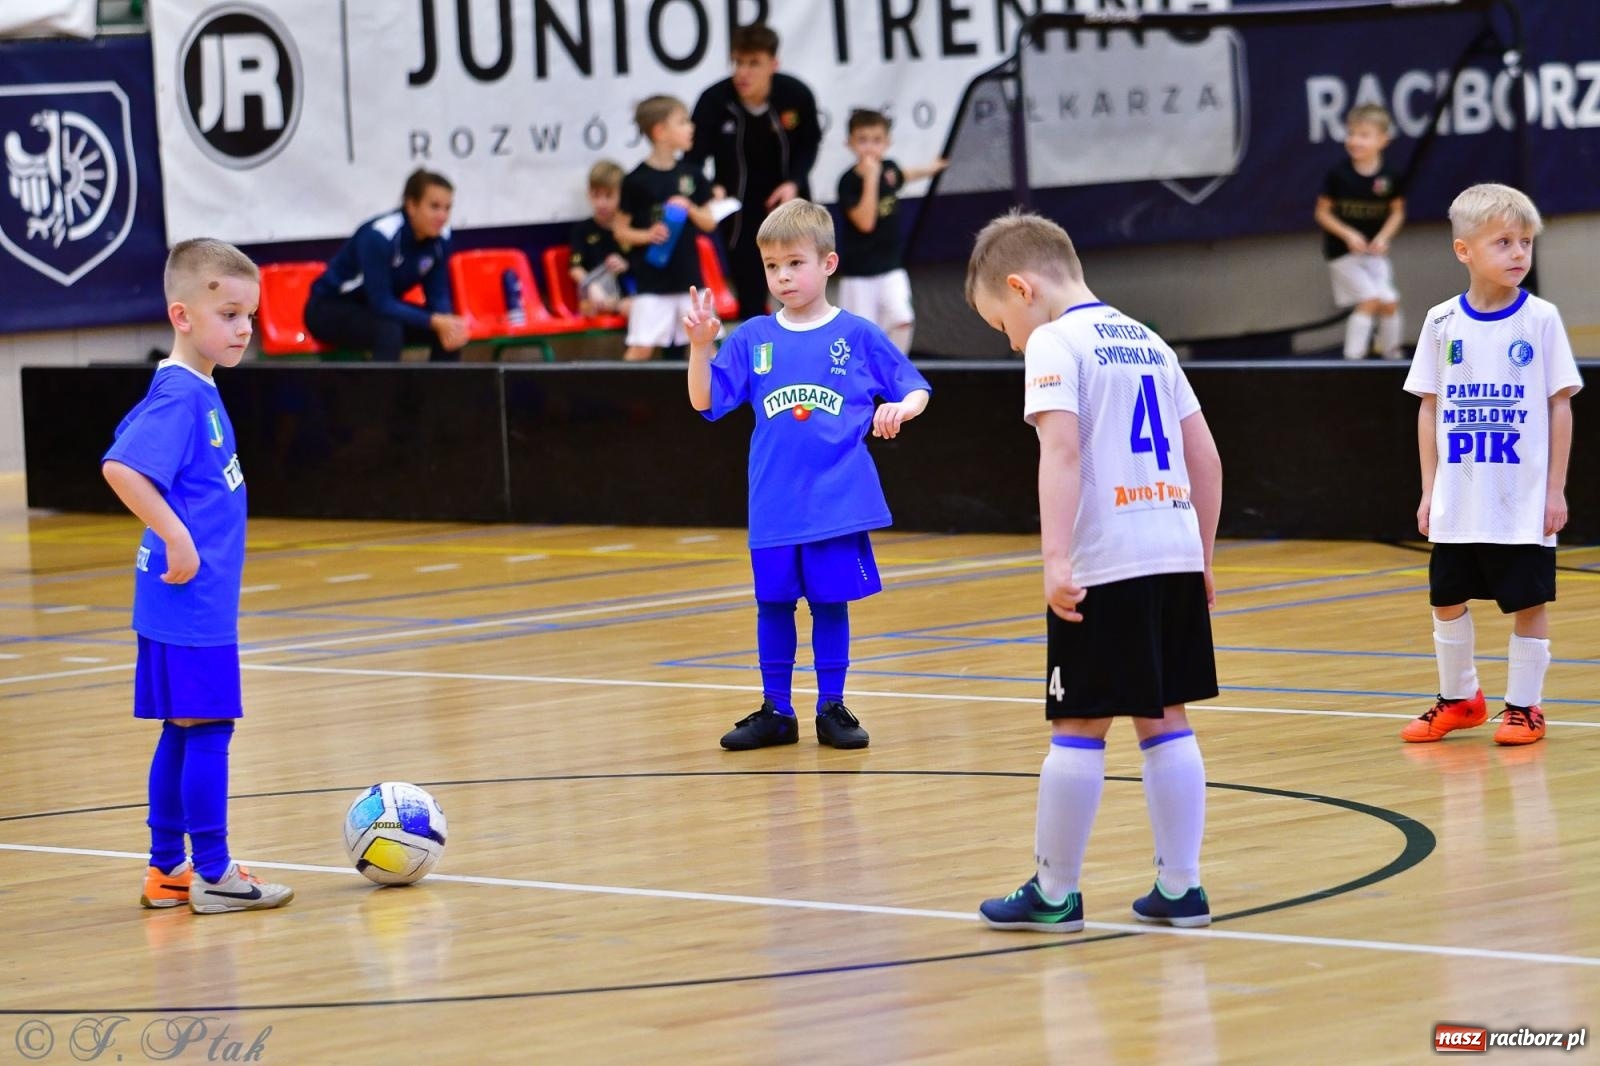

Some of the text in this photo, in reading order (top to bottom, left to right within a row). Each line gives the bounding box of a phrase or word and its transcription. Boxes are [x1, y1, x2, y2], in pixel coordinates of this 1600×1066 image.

[198, 32, 285, 133] JR
[1094, 323, 1150, 341] FORTECA
[766, 388, 838, 412] TYMBARK
[1446, 384, 1525, 399] PAWILON
[1130, 375, 1170, 471] 4
[1443, 408, 1528, 424] MEBLOWY
[1447, 431, 1521, 464] PIK
[1049, 666, 1065, 702] 4
